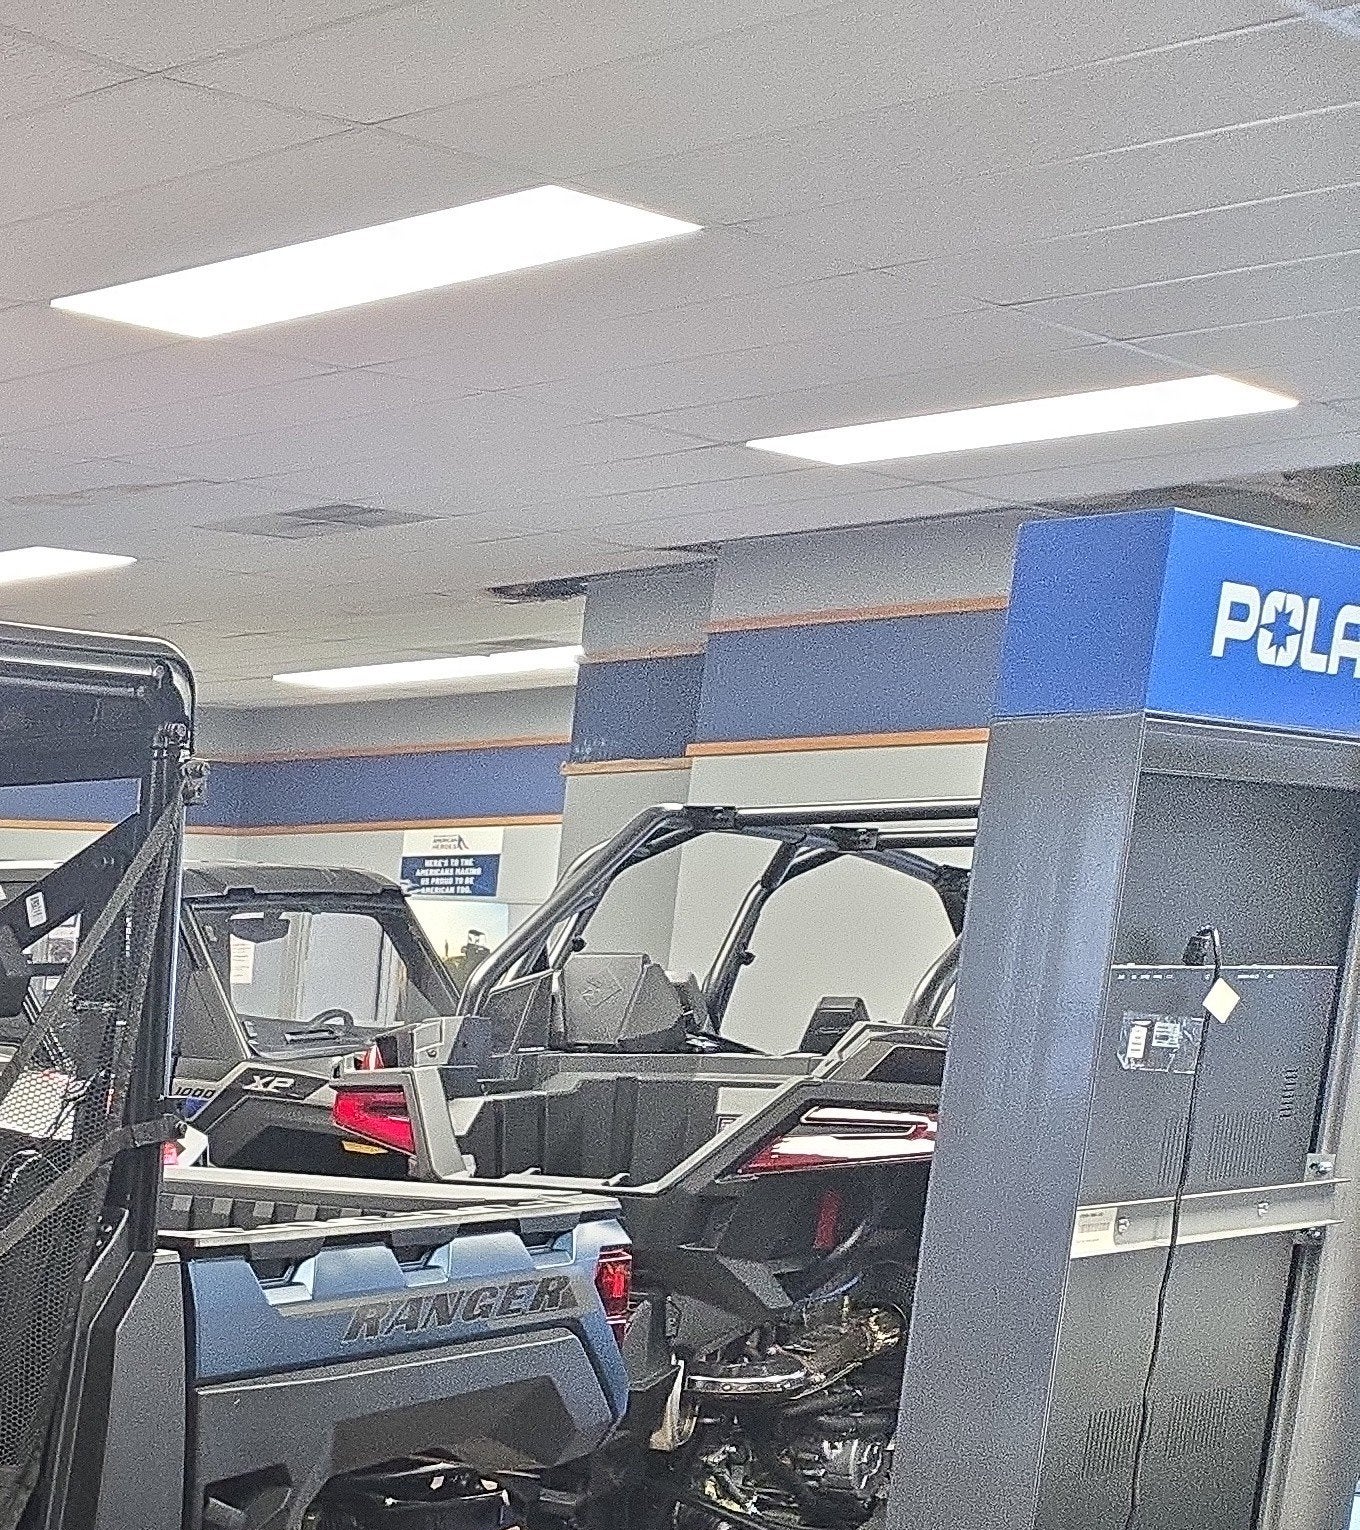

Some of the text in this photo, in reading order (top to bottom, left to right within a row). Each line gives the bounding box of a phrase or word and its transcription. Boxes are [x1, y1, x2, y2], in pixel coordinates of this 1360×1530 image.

[1210, 580, 1360, 680] POLA
[175, 1075, 295, 1099] 1000 XP
[340, 1274, 580, 1345] RANGER
